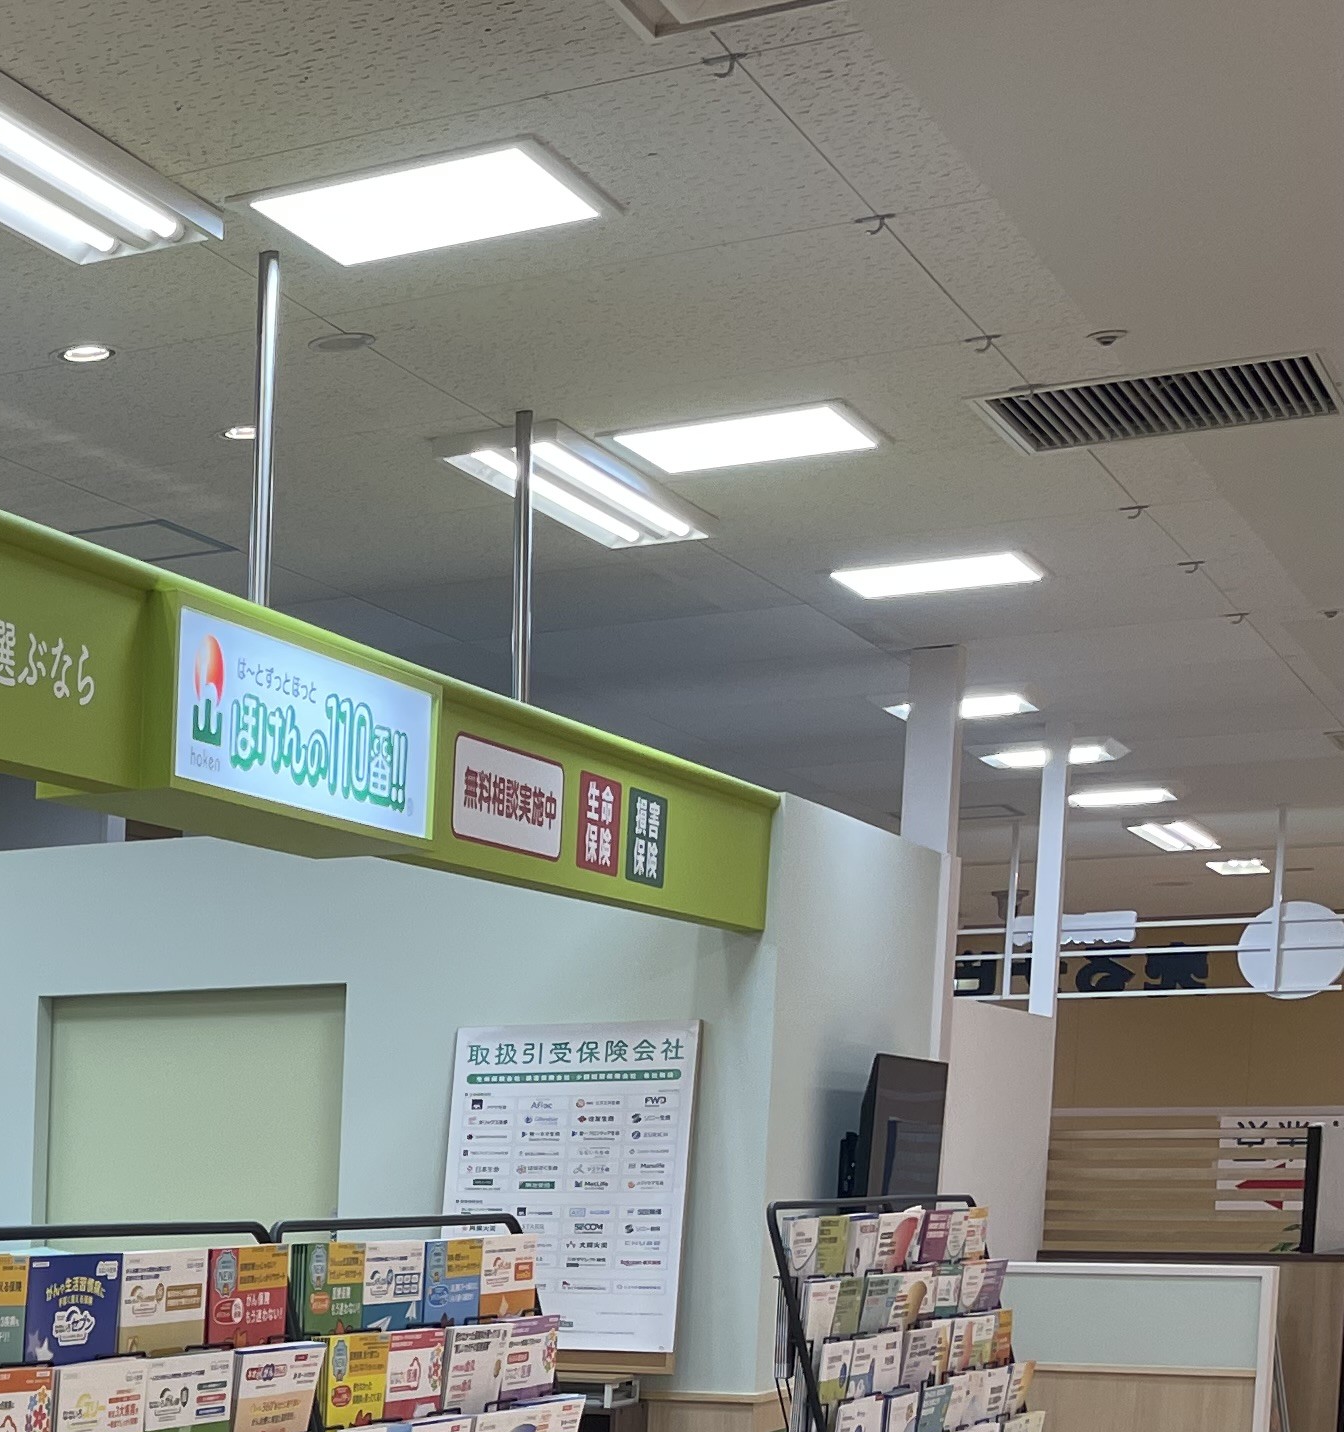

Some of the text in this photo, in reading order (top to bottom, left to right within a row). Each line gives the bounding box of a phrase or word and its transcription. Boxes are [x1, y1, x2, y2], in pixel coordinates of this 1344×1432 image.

[190, 747, 220, 772] hoken
[463, 766, 557, 831] 無料相談実施中
[586, 781, 615, 825] 生命
[636, 796, 662, 839] 損害
[585, 823, 612, 867] 保険
[634, 838, 658, 879] 保険
[467, 1038, 685, 1065] 取扱引受保険会社
